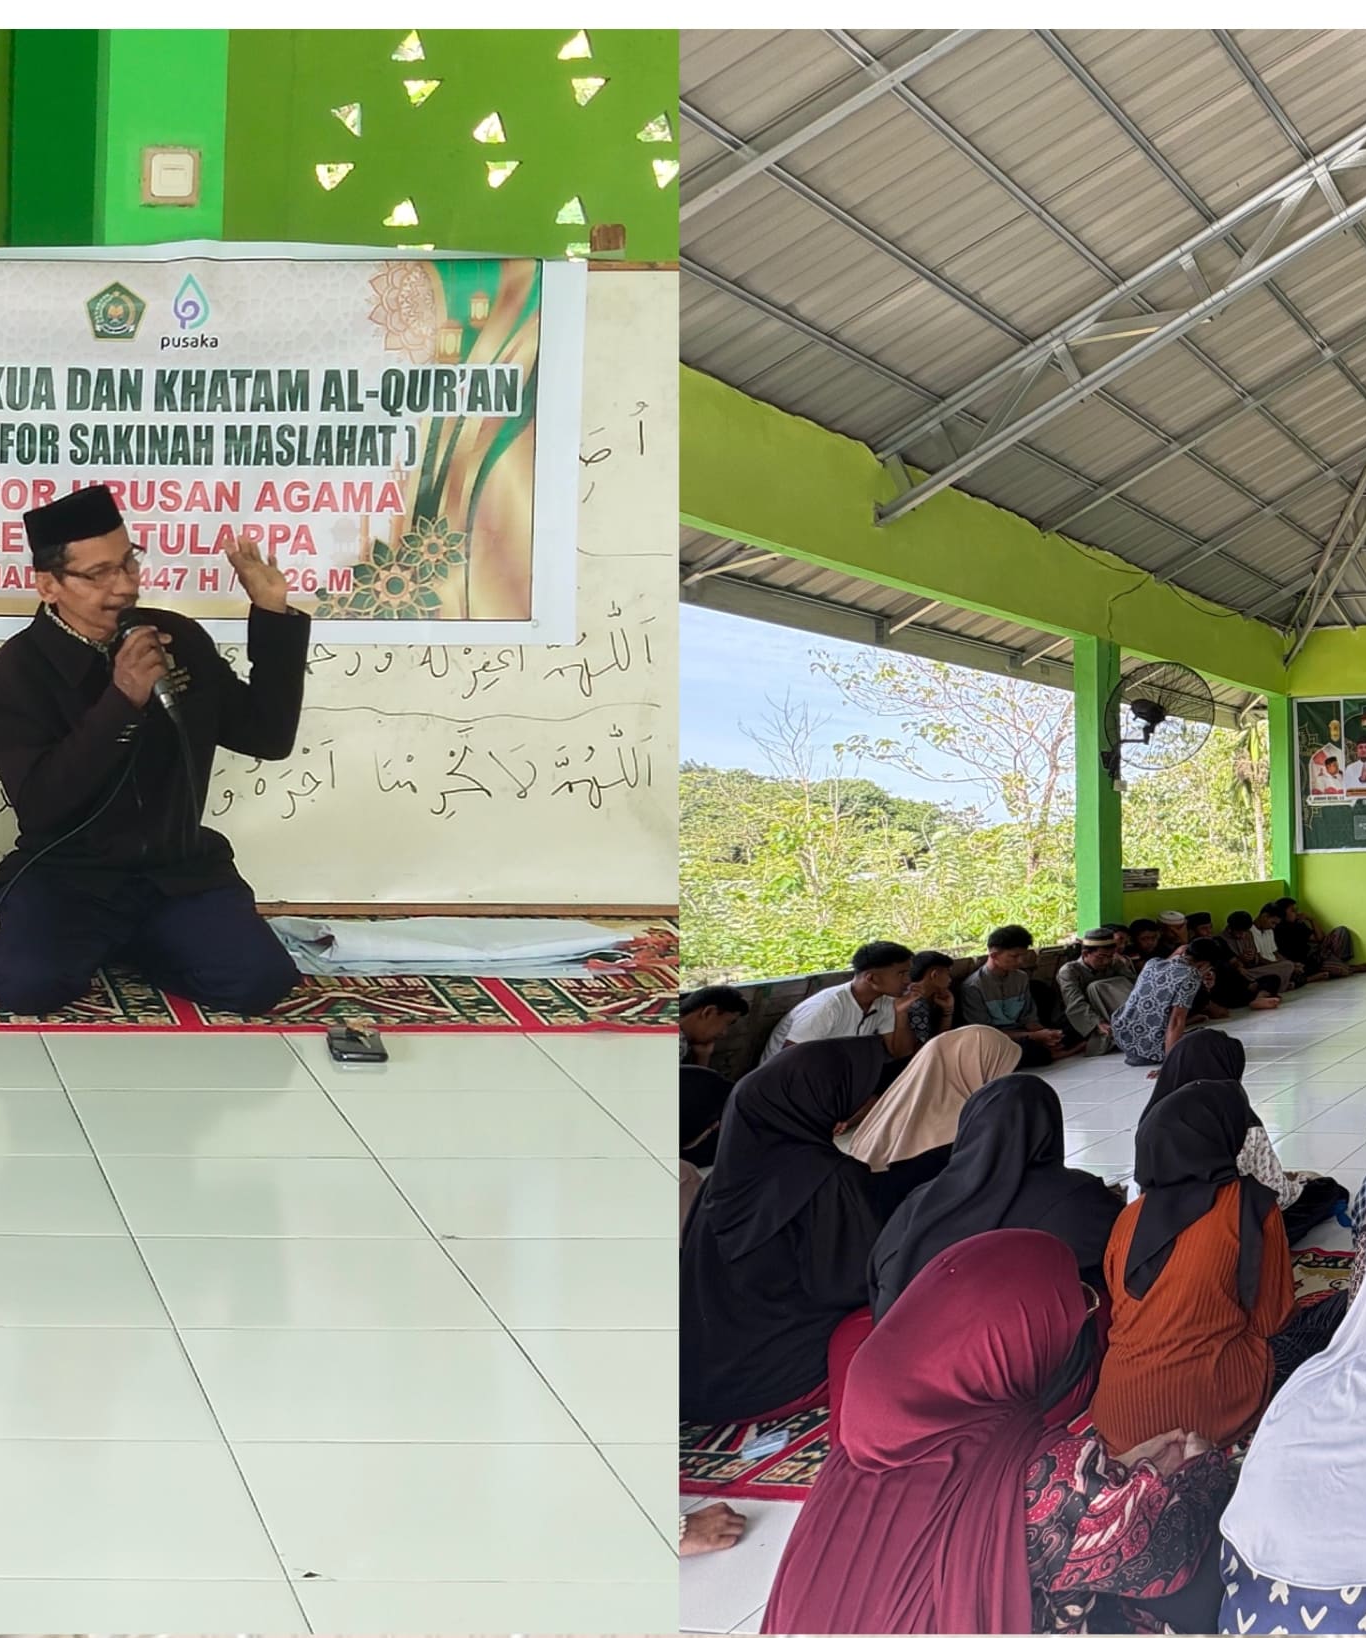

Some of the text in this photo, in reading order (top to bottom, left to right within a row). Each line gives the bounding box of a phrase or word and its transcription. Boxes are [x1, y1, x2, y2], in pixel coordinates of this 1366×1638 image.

[160, 333, 219, 350] pusaka
[66, 366, 143, 412] DAN
[154, 367, 310, 413] KHATAM
[69, 423, 214, 467] SAKINAH
[223, 424, 397, 467] MASLAHAT
[72, 479, 241, 513] RUSAN
[254, 480, 404, 513] AGAMA
[131, 523, 317, 555] TULAPPA
[138, 567, 188, 592] 447
[198, 567, 220, 592] H
[327, 567, 353, 592] M
